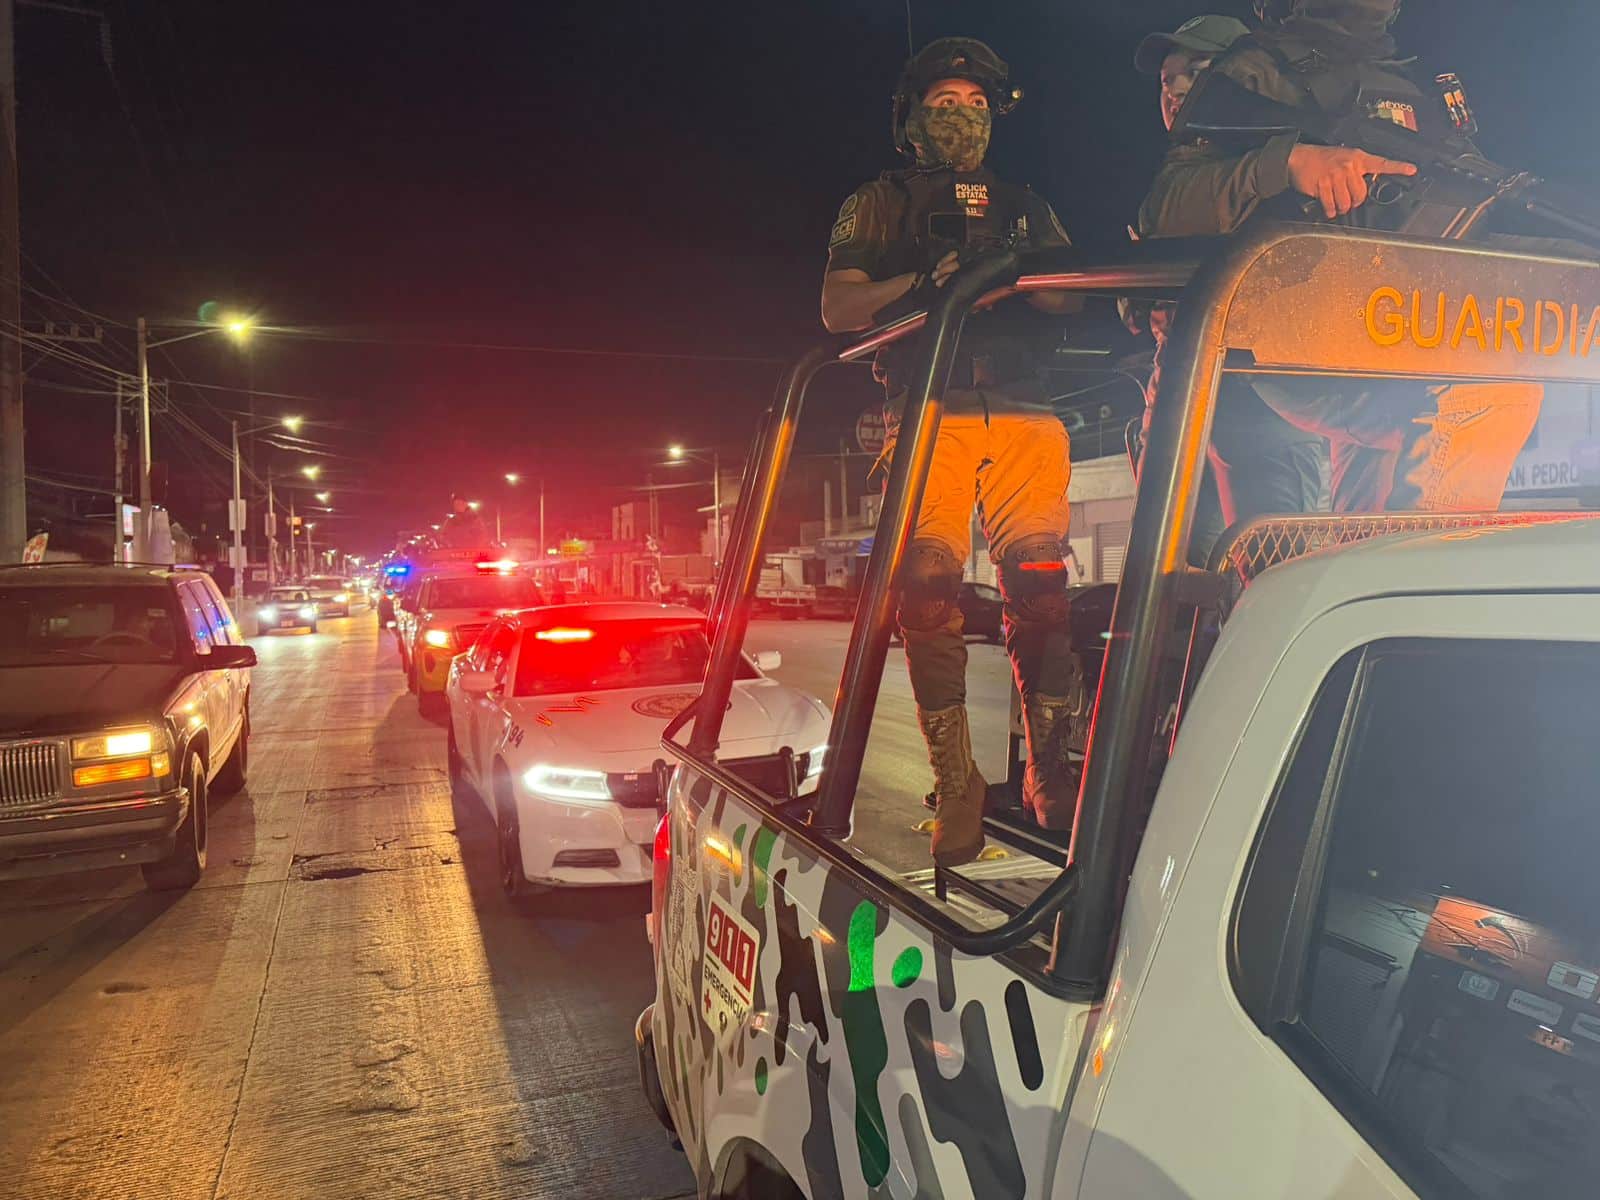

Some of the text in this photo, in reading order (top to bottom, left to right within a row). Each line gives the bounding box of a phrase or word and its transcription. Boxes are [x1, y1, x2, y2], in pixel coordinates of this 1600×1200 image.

[956, 191, 989, 200] ESTATAL
[1365, 286, 1600, 358] GUARDIA
[710, 913, 750, 980] 911
